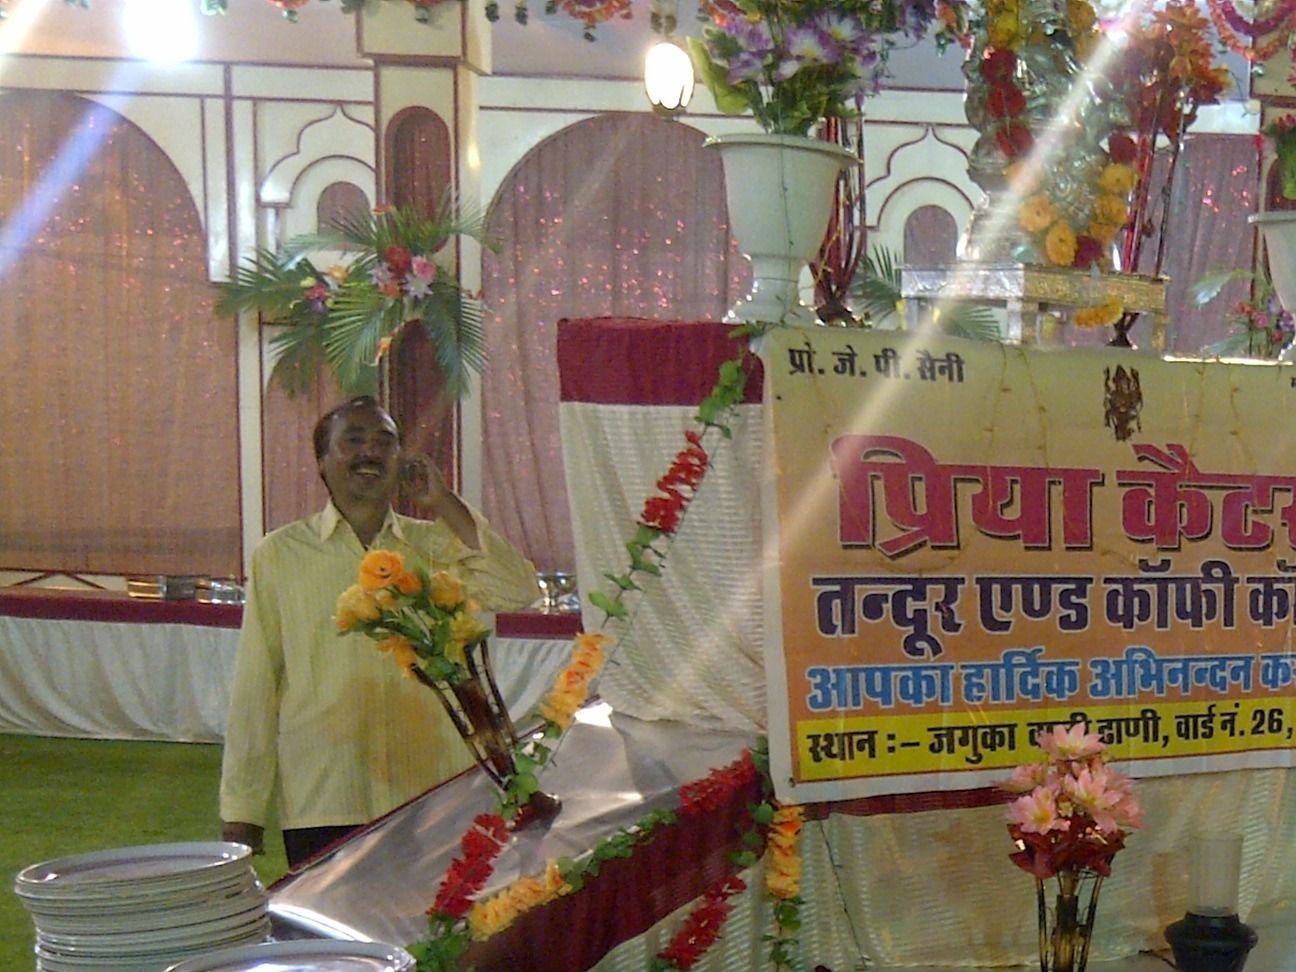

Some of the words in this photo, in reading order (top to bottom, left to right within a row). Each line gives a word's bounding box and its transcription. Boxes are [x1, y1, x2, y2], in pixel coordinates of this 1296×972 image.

[832, 345, 867, 377] जे.
[873, 348, 911, 379] पी.
[916, 349, 966, 384] सैनी
[831, 434, 1104, 558] प्रिया
[811, 576, 966, 658] तन्दूर
[975, 577, 1094, 633] एण्ड
[1103, 558, 1240, 630] कॉफी
[805, 664, 955, 710] आपका
[960, 647, 1081, 704] हार्दिक
[1088, 646, 1255, 698] अभिनन्दन
[927, 723, 1018, 764] जगुका
[1174, 705, 1217, 741] वार्ड
